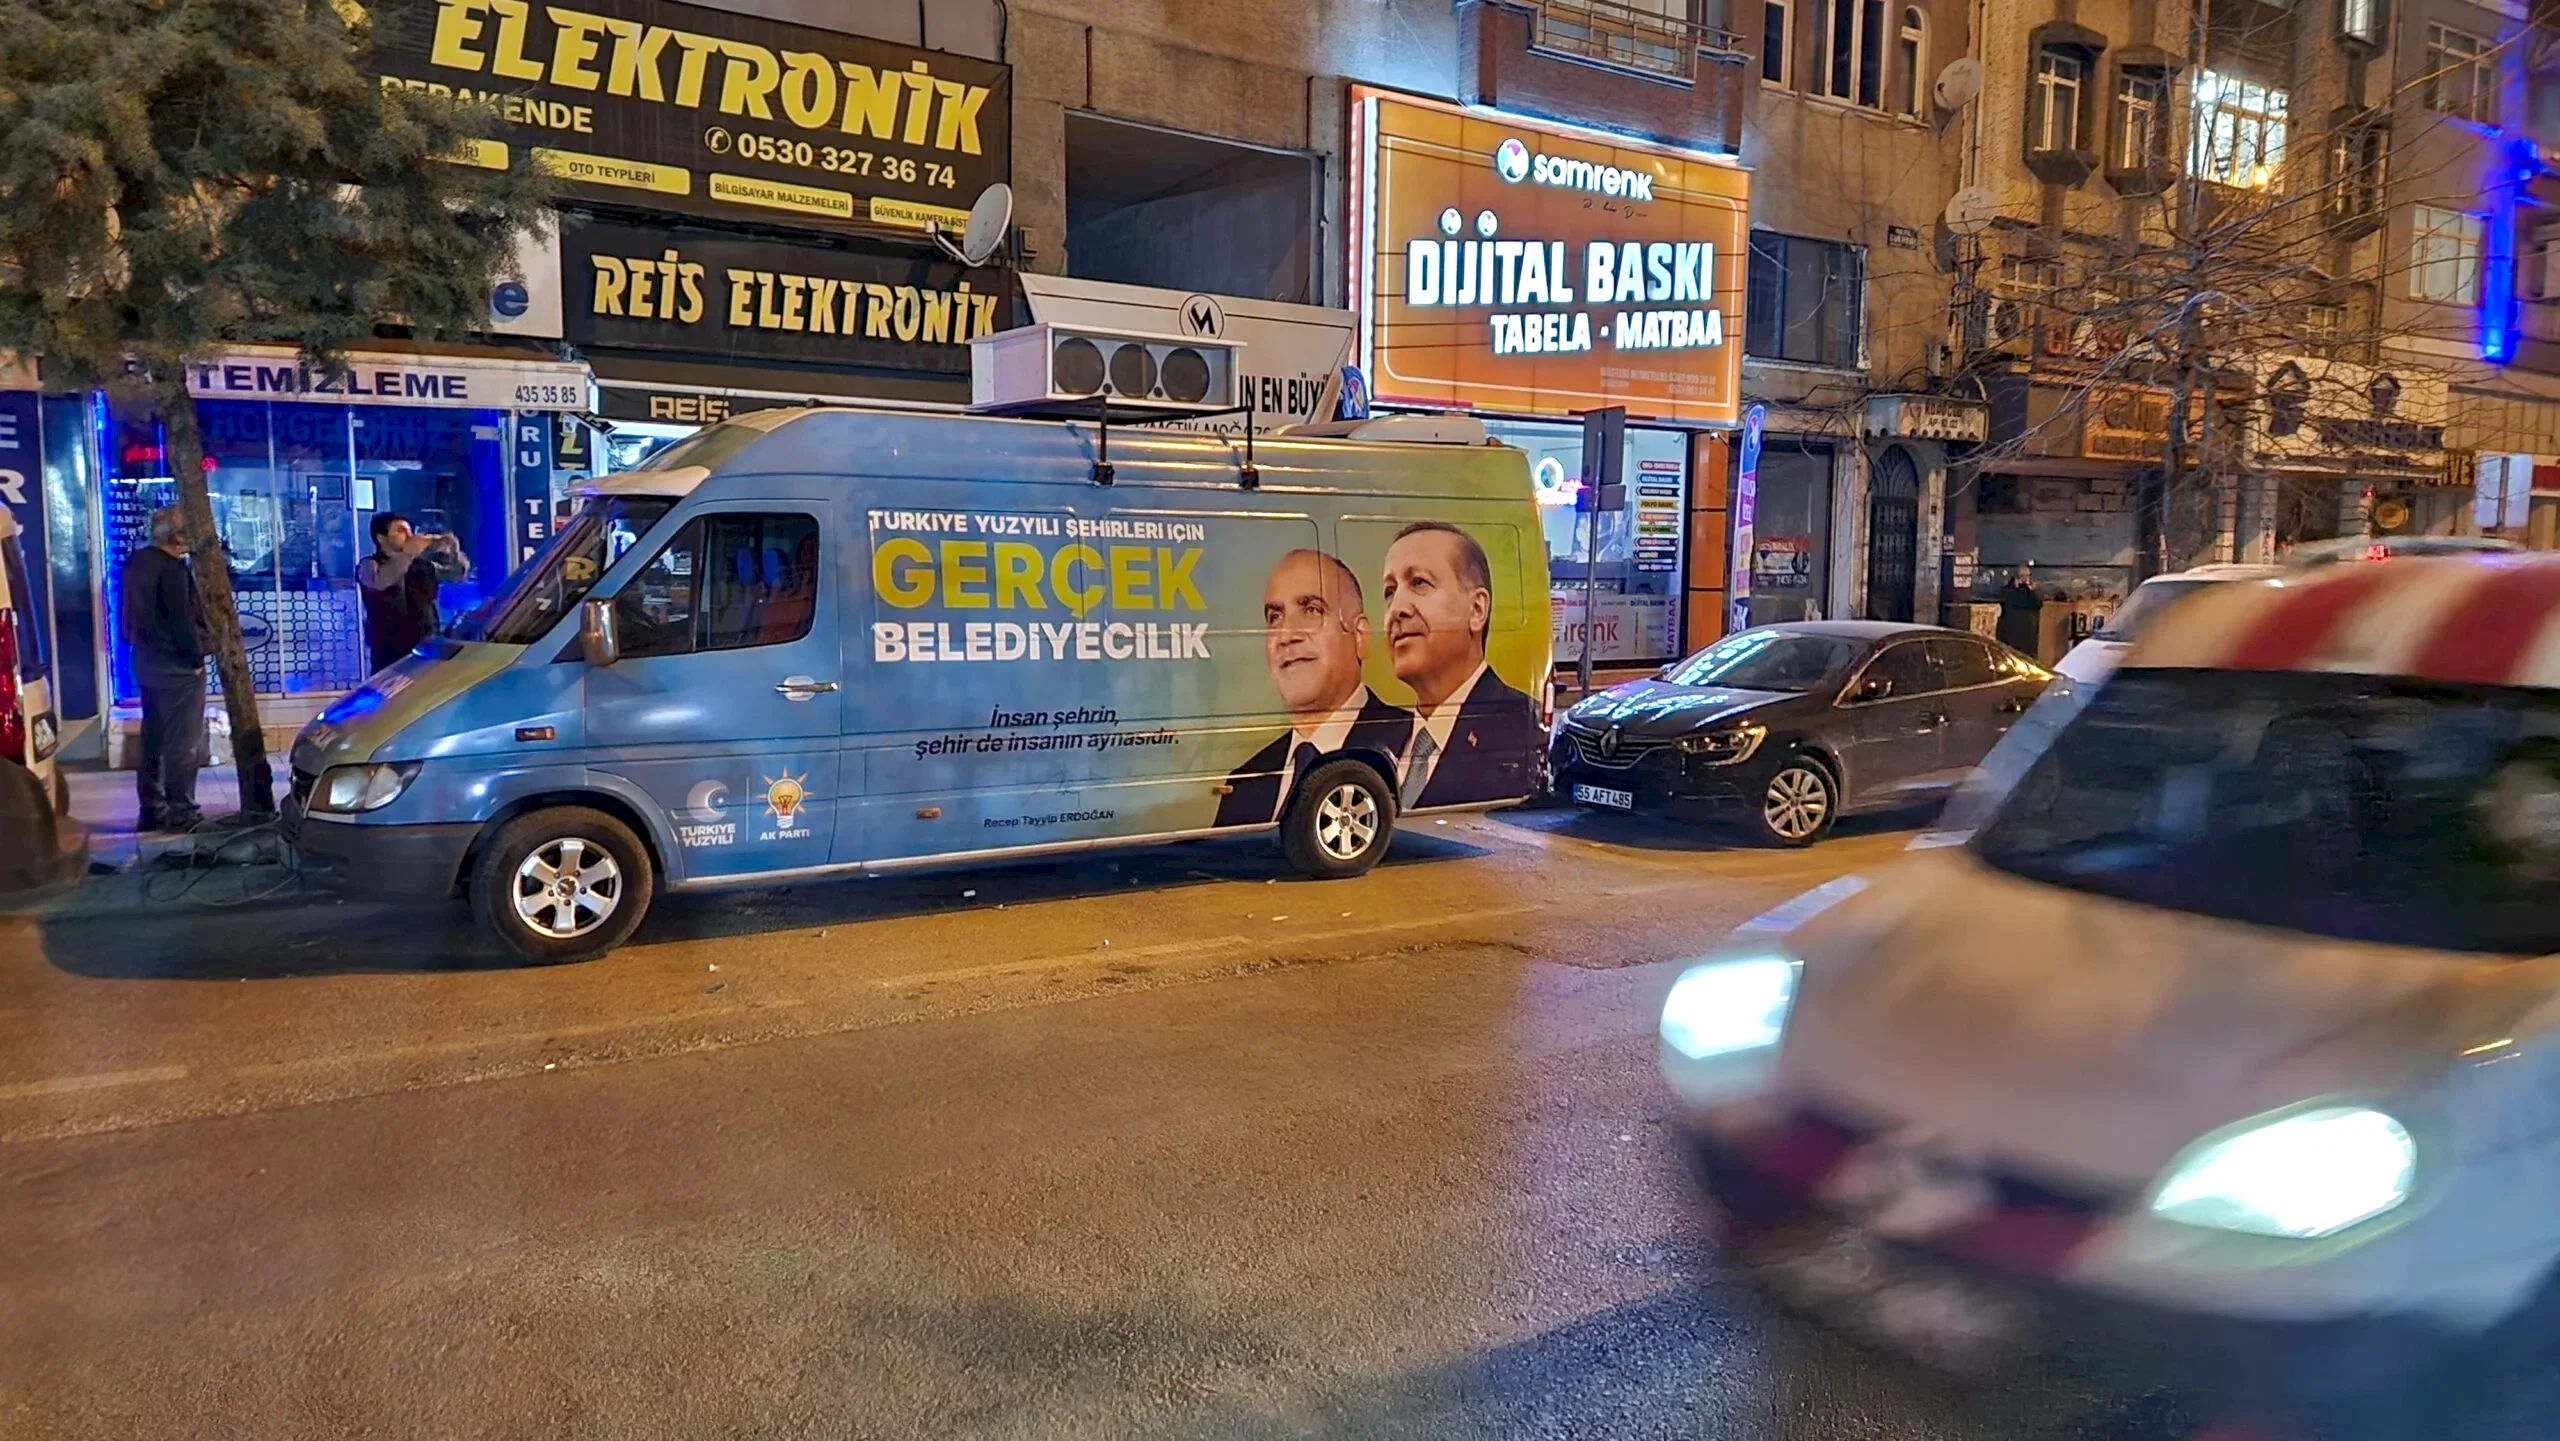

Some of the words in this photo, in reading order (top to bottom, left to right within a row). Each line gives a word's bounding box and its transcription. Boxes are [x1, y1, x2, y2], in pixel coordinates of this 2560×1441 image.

[431, 0, 992, 155] ELEKTRONİK
[569, 162, 594, 175] OTO
[597, 165, 655, 184] TEYPLERİ
[737, 133, 813, 167] 0530
[820, 146, 874, 176] 327
[881, 156, 917, 183] 36
[924, 162, 956, 189] 74
[1533, 153, 1653, 200] samrenk
[714, 180, 775, 200] BİLGİSAYAR
[777, 189, 849, 211] MALZEMELERİ
[873, 203, 914, 221] GÜVENLİK
[1407, 208, 1574, 306] DİJİTAL
[1587, 241, 1715, 302] BASKI
[591, 248, 706, 325] REİS
[726, 266, 998, 346] ELEKTRONİK
[1490, 312, 1593, 354] TABELA
[1615, 309, 1723, 349] MATBAA
[515, 384, 539, 402] 435
[542, 385, 557, 403] 35
[561, 386, 577, 404] 85
[1261, 376, 1282, 413] EN
[873, 538, 1208, 620] GERÇEK
[990, 704, 1049, 728] İnsan
[1052, 705, 1120, 730] şehrin,
[915, 734, 973, 761] şehir
[976, 733, 1003, 753] de
[1008, 731, 1083, 752] insanın
[1087, 726, 1180, 752] aynasıdır.
[1577, 785, 1590, 800] 55
[1592, 789, 1612, 804] AFT
[760, 831, 776, 841] AK
[983, 817, 1019, 829] Recep
[1060, 808, 1115, 823] ERDOĞAN
